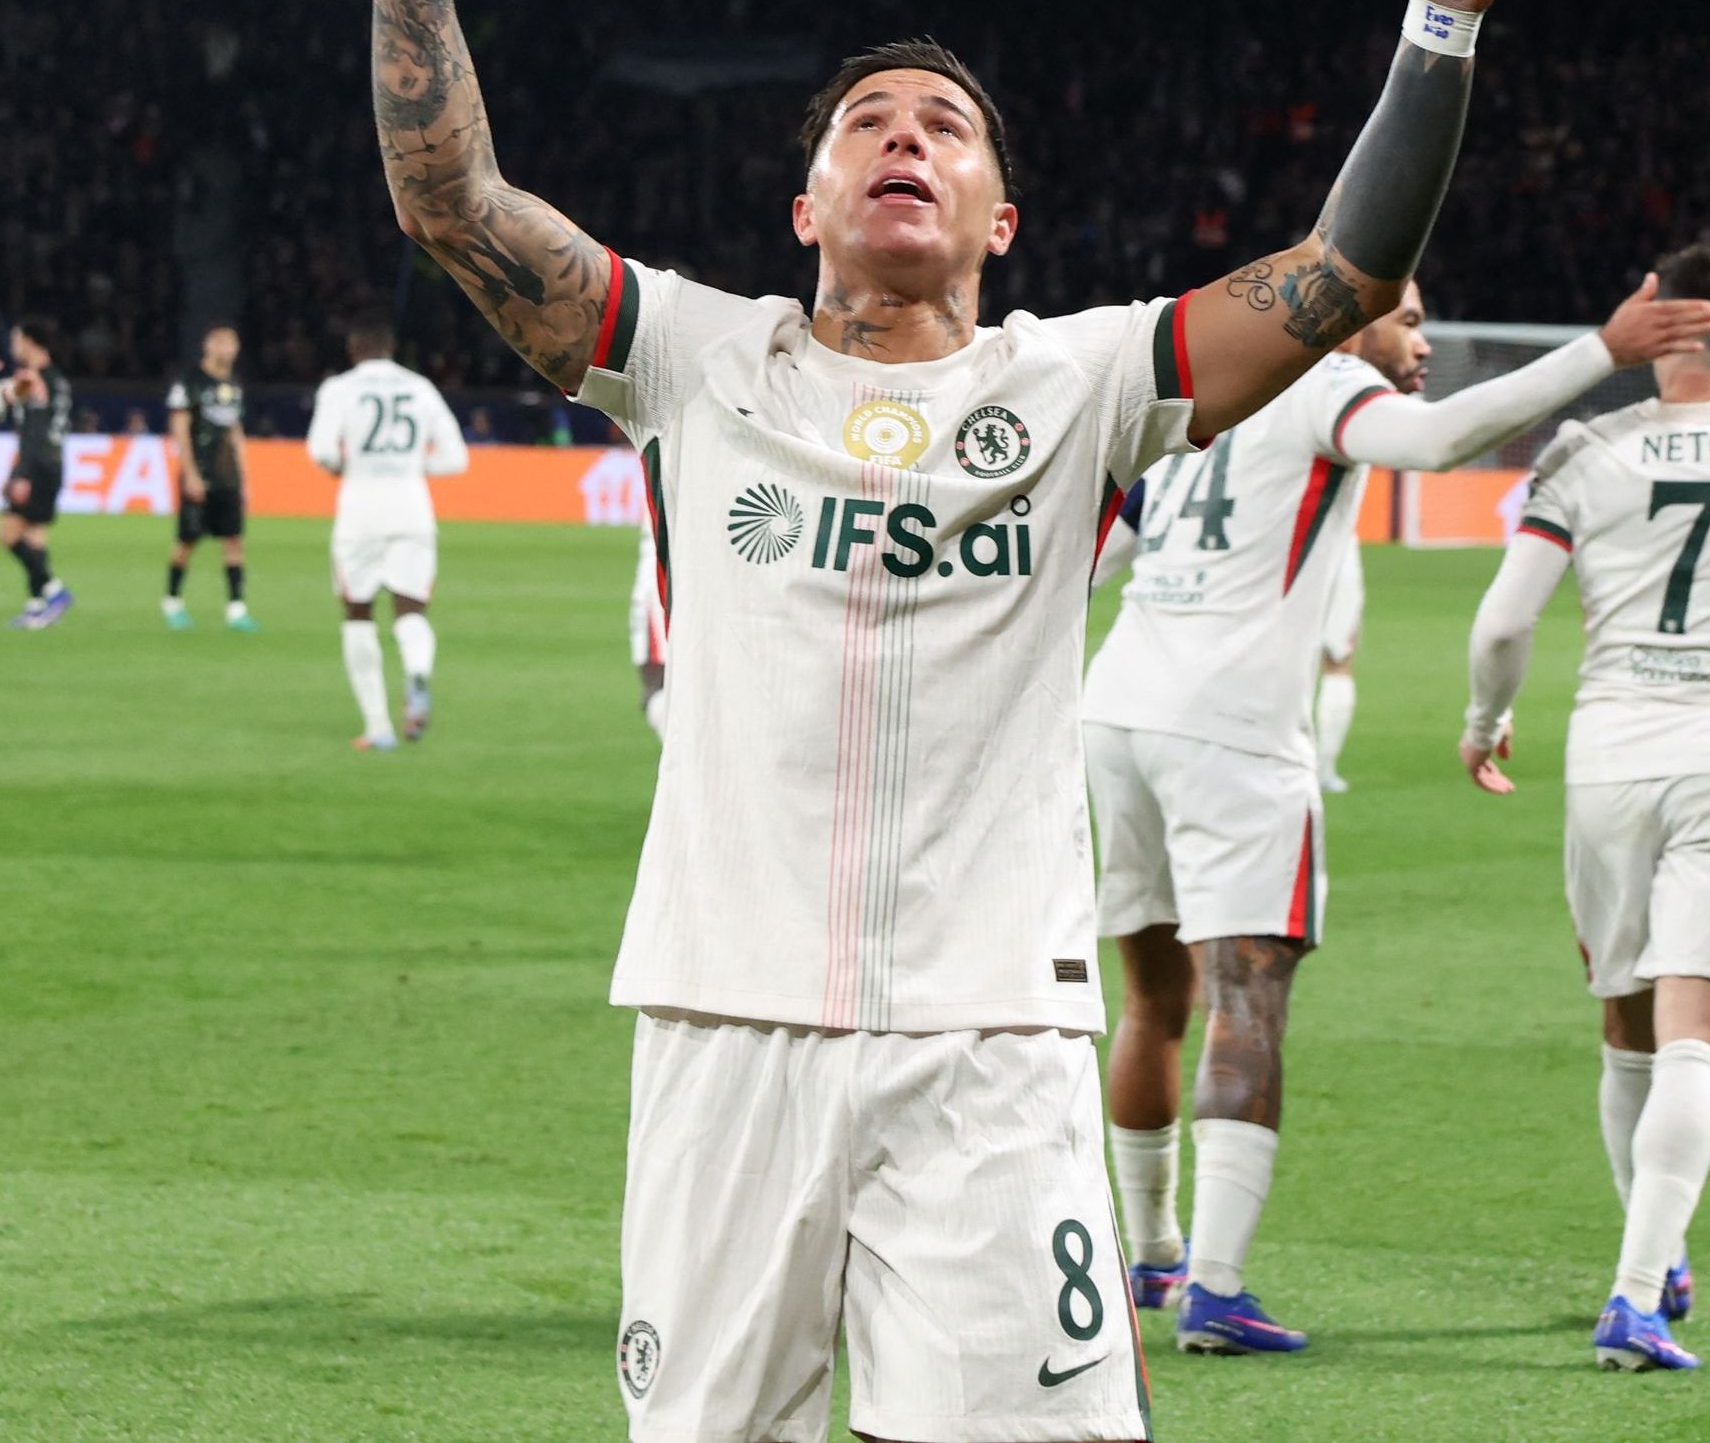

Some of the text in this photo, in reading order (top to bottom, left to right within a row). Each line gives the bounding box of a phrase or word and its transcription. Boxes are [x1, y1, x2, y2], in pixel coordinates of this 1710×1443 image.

[359, 392, 418, 454] 25
[874, 405, 923, 445] CHAMPIONS
[961, 407, 1008, 431] CHELSEA
[59, 434, 178, 514] EA
[811, 494, 1033, 579] IFS.ai
[1051, 1218, 1104, 1342] 8
